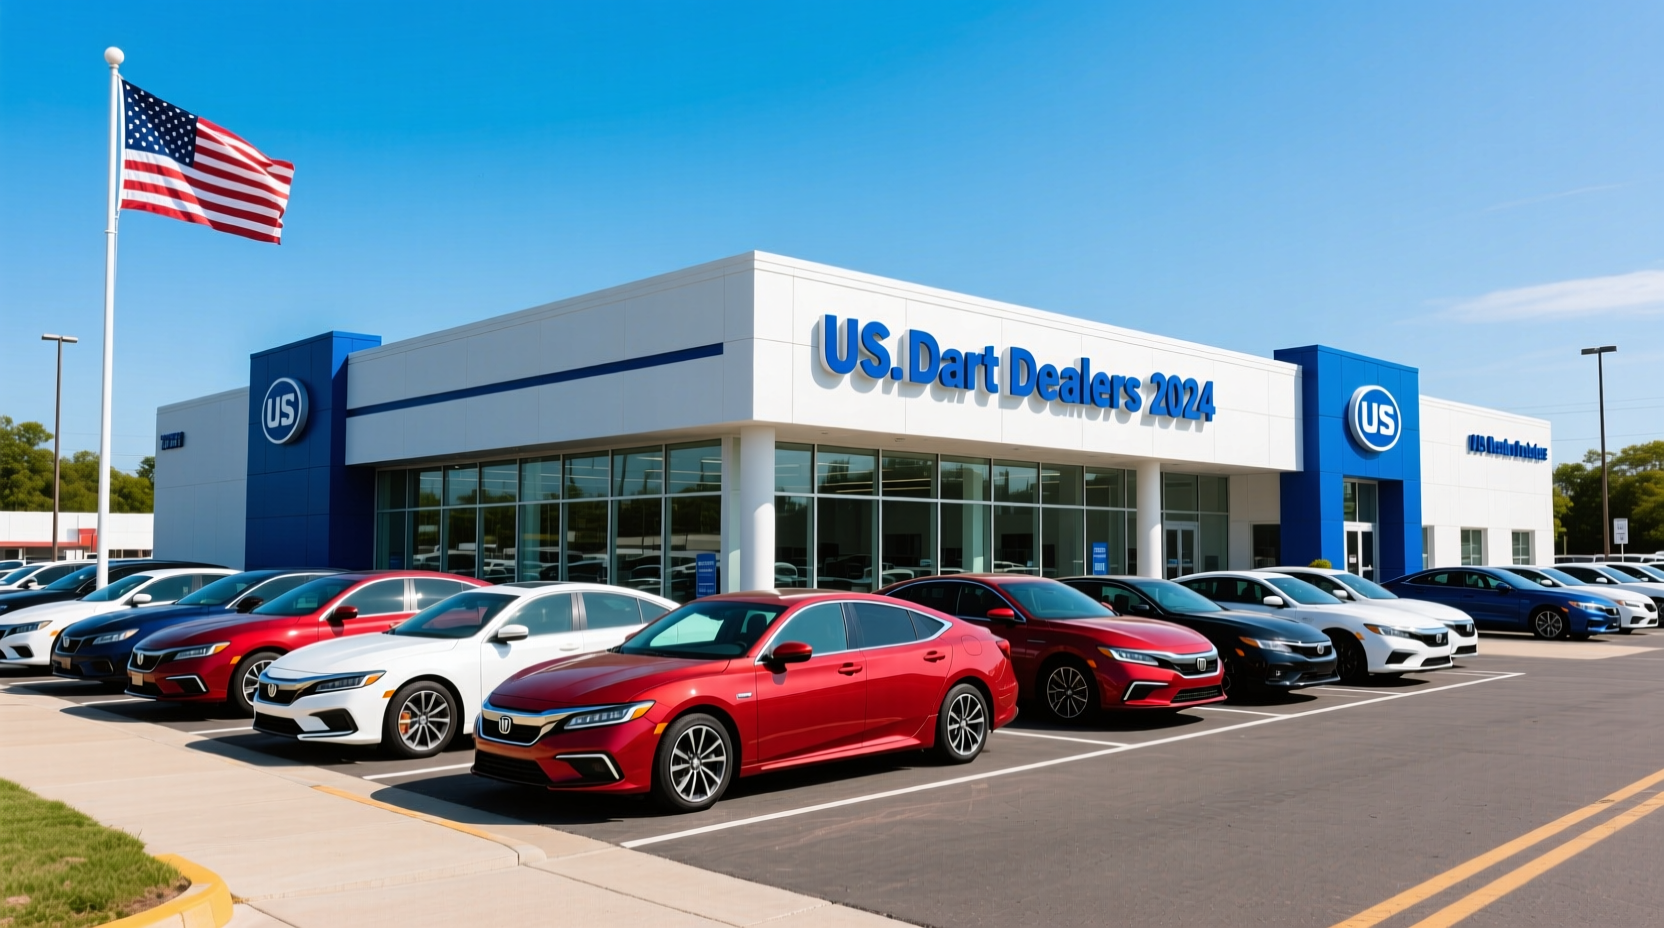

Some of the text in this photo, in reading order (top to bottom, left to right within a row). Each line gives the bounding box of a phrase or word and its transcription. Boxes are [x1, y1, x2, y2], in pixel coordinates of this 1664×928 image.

[1009, 346, 1142, 412] Dealers
[1149, 372, 1216, 422] 2024
[267, 393, 294, 428] US
[1361, 401, 1395, 436] US
